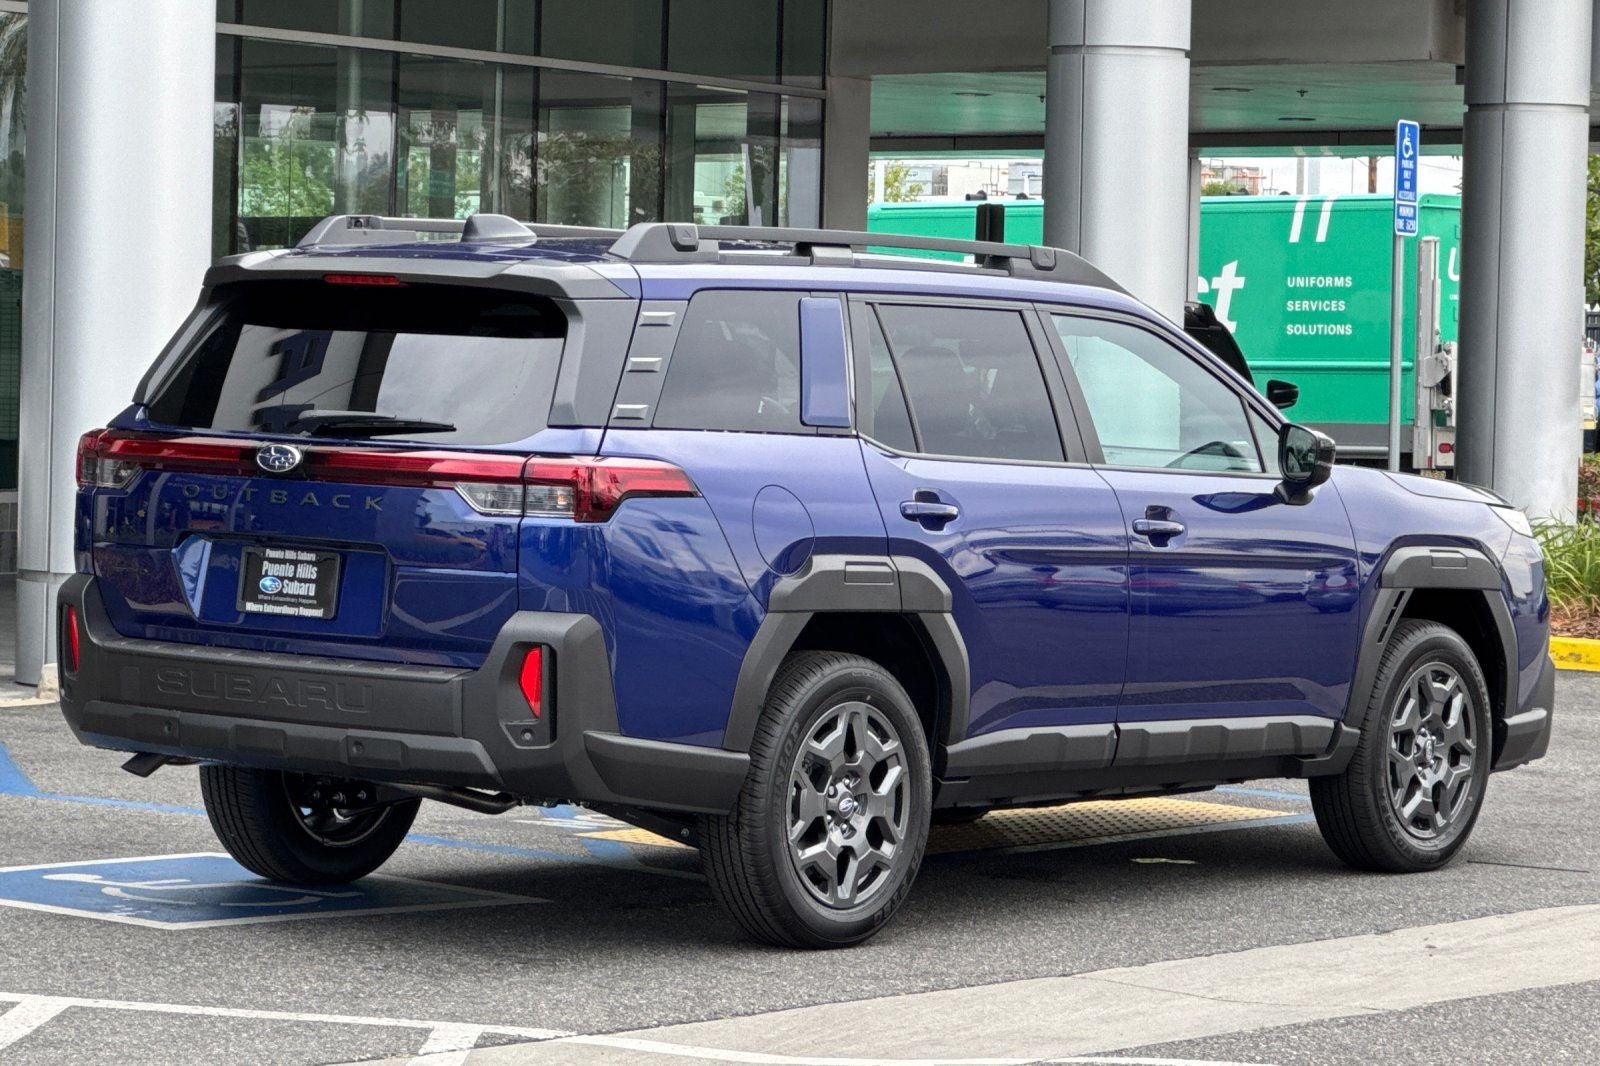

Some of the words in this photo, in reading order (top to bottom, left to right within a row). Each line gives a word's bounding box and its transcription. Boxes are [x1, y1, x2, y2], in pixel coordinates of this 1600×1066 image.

[1287, 276, 1353, 288] UNIFORMS
[1286, 300, 1346, 311] SERVICES
[1286, 324, 1353, 335] SOLUTIONS
[182, 484, 384, 511] OUTBACK
[262, 561, 295, 577] Puente
[296, 563, 318, 579] Hills
[282, 579, 316, 596] Subaru
[156, 665, 374, 714] SUBARU
